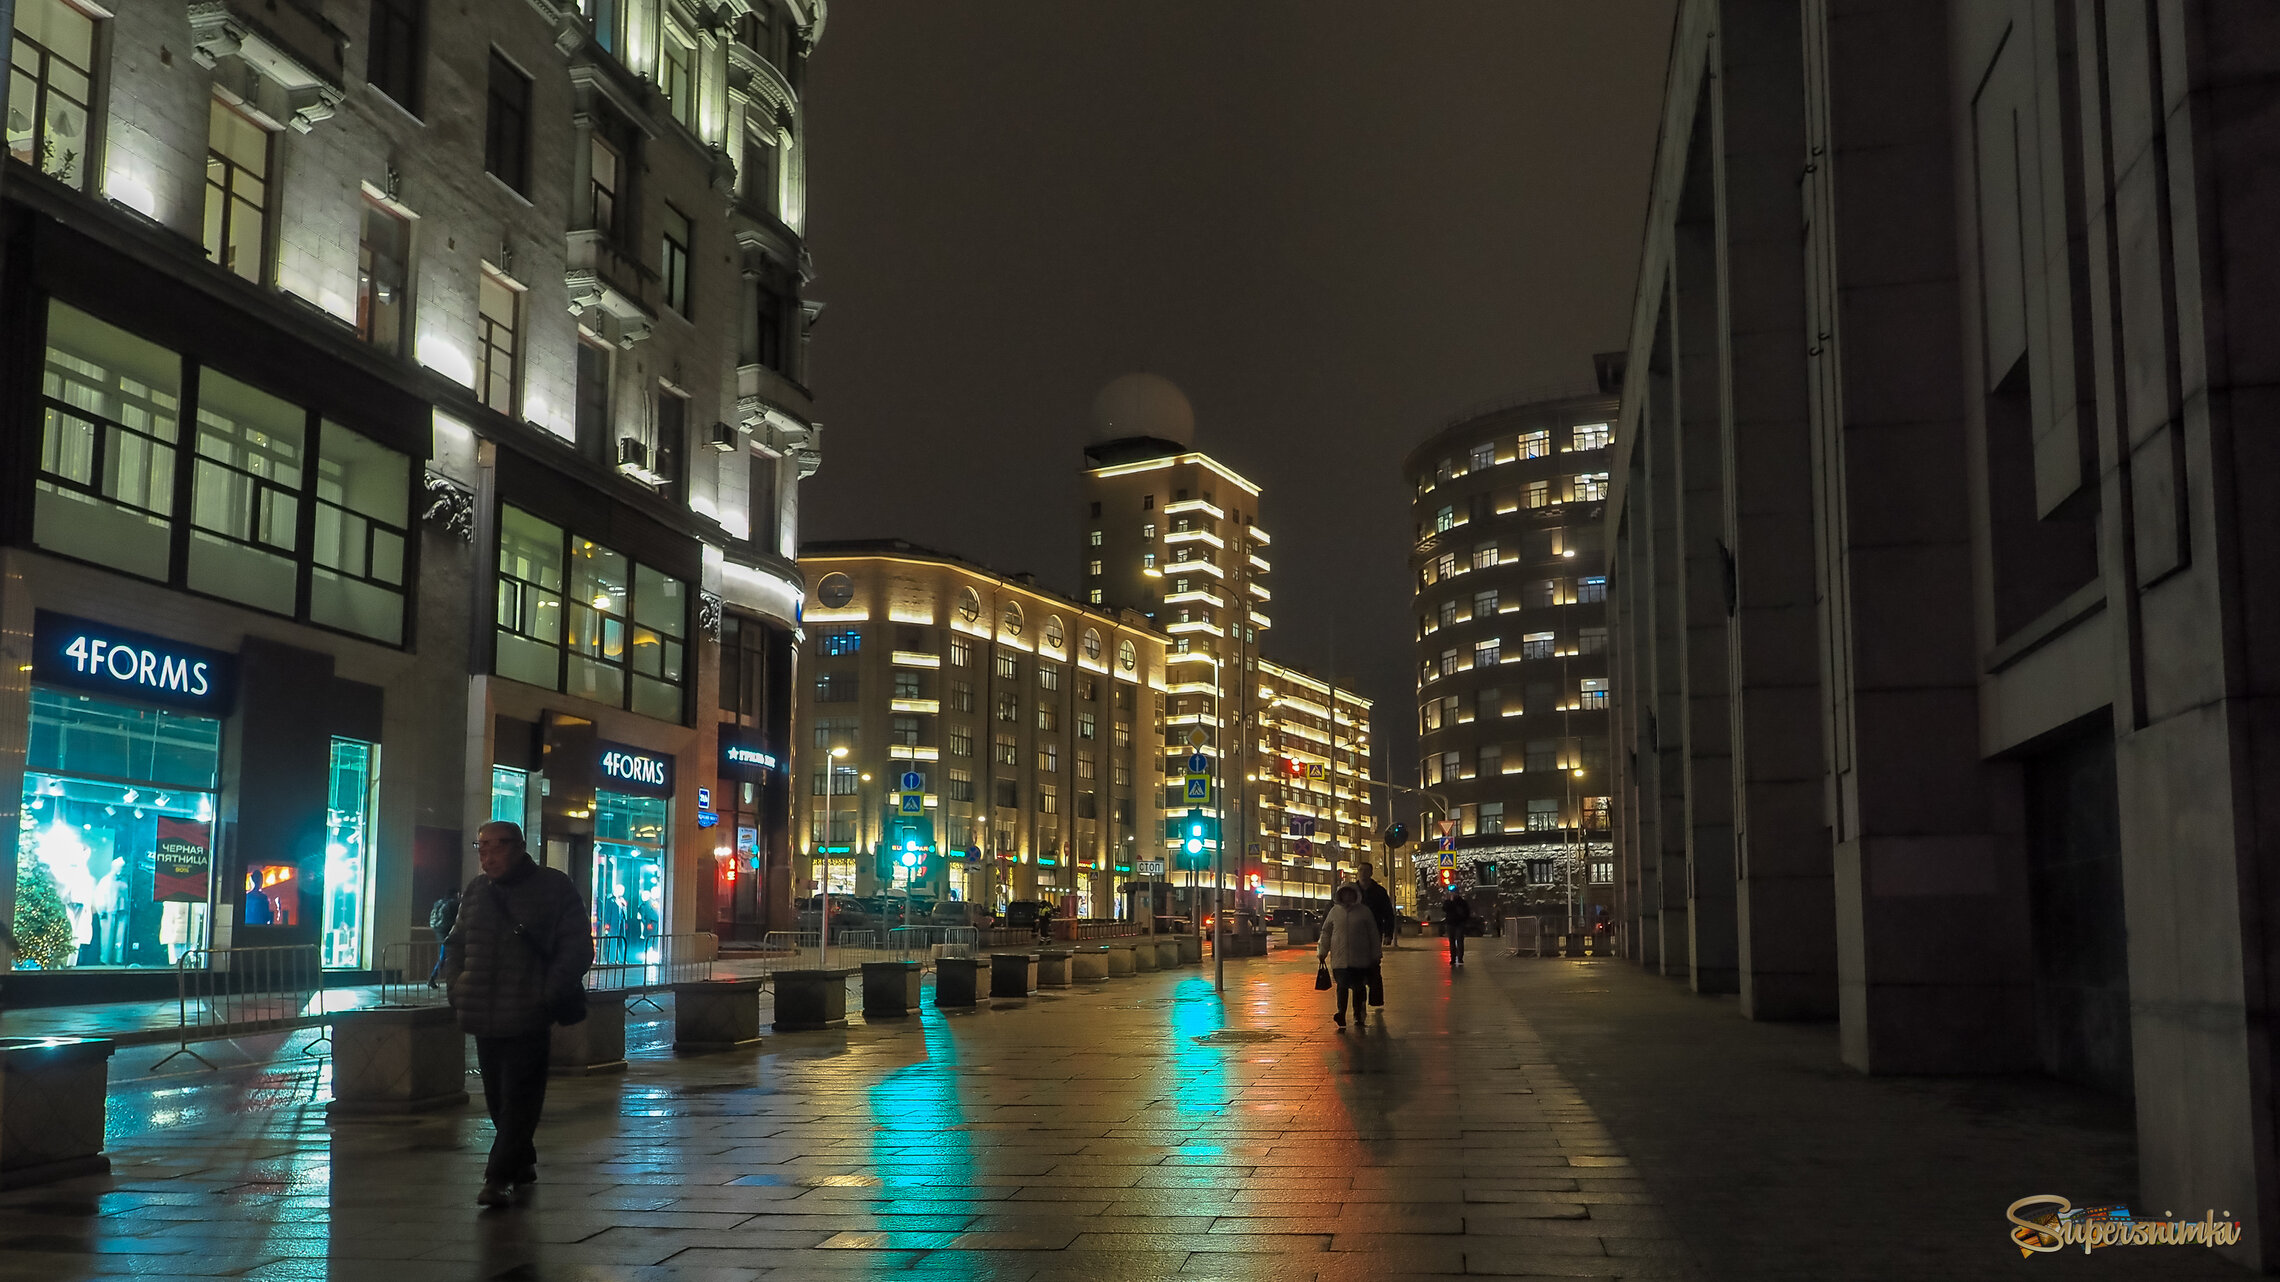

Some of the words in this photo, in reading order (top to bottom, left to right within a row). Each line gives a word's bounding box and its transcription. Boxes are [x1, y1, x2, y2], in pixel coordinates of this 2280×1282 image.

[65, 636, 208, 695] 4FORMS
[602, 751, 664, 785] 4FORMS
[162, 843, 204, 855] ЧЕРНАЯ
[157, 853, 208, 866] ПЯТНИЦА
[1139, 862, 1161, 872] СТОП
